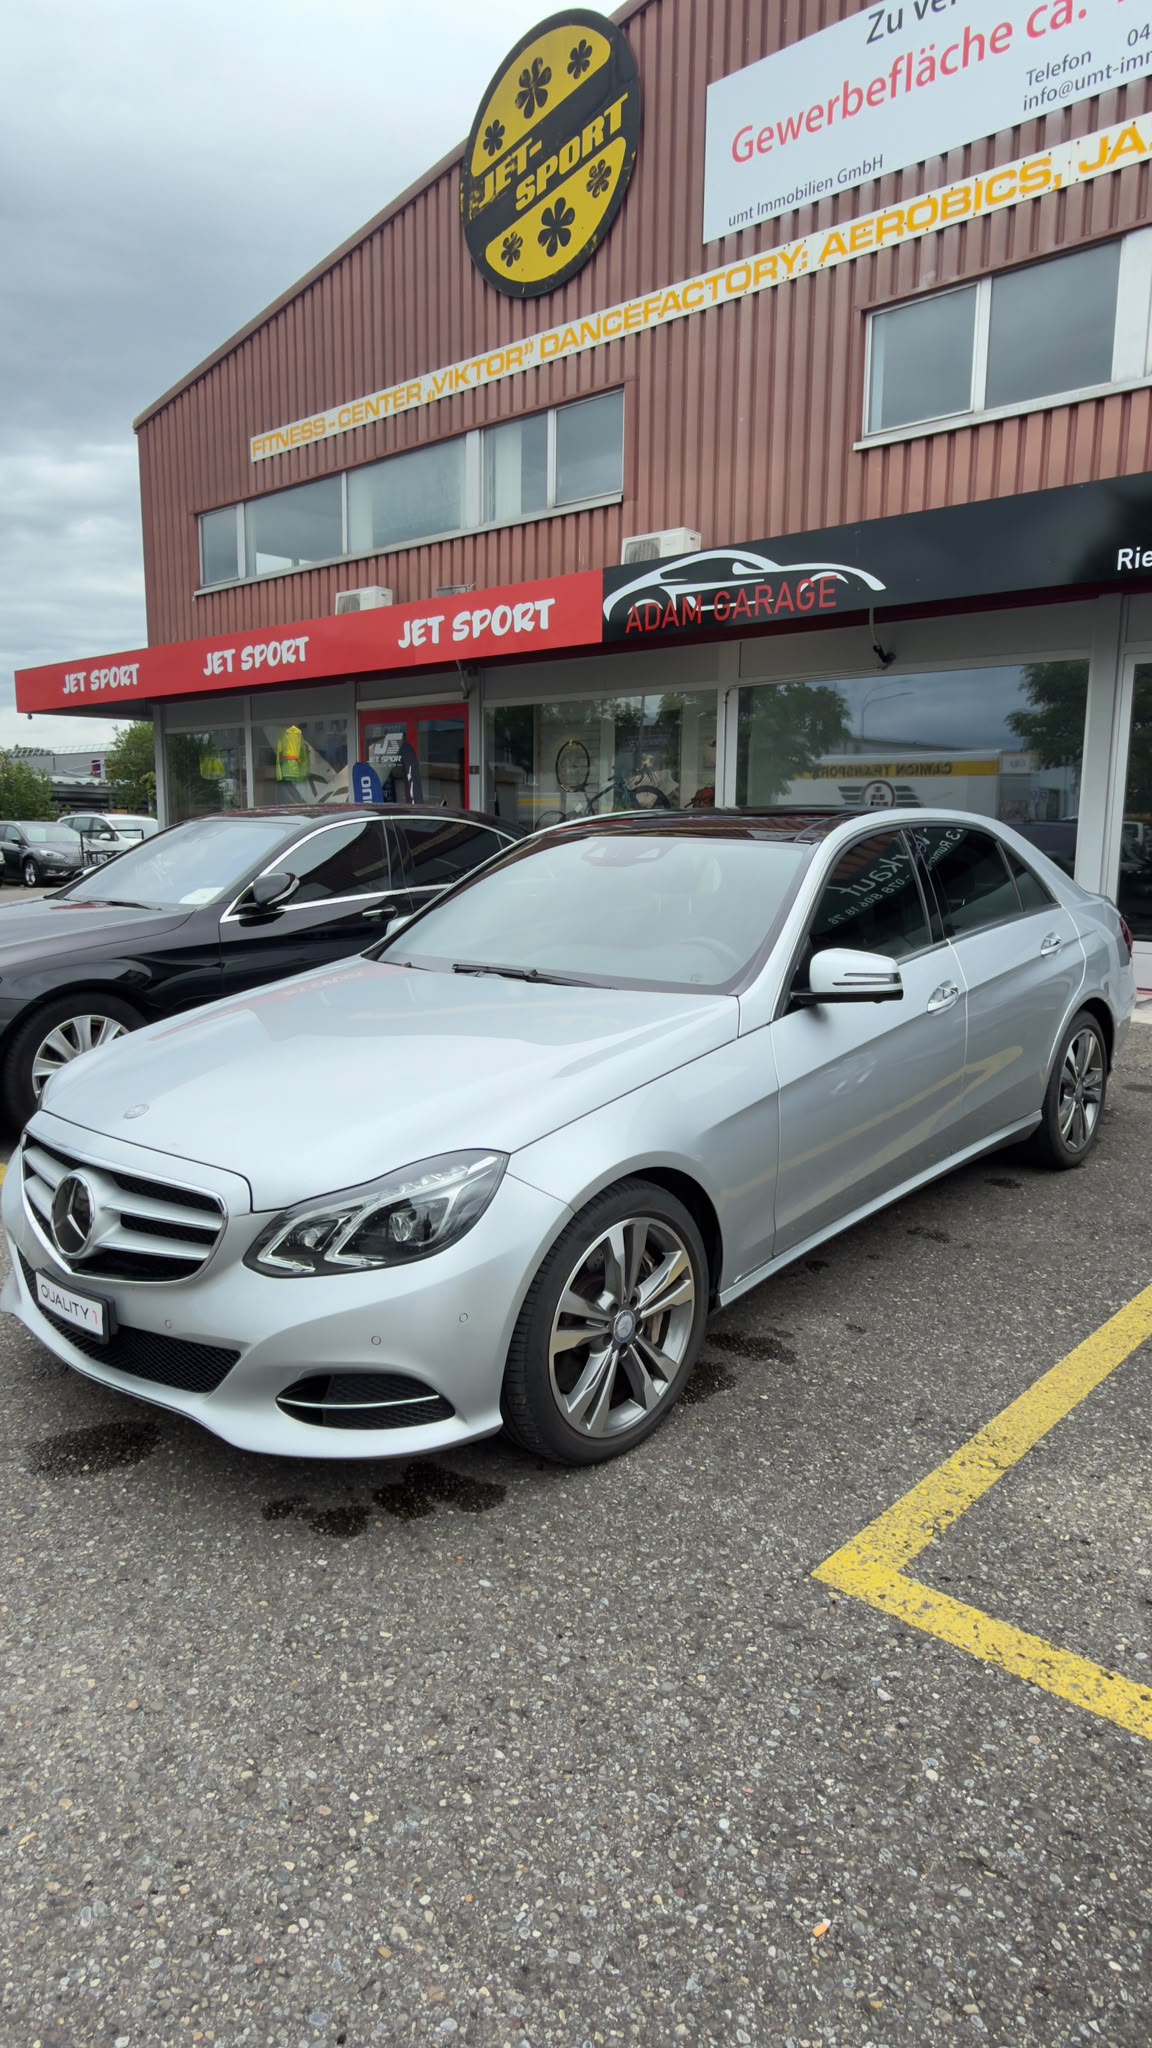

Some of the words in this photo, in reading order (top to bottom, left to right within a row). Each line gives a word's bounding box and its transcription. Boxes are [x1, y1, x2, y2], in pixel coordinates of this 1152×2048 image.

[866, 8, 903, 45] Zu
[1026, 51, 1092, 86] Telefon
[1127, 23, 1151, 47] 04
[732, 22, 1013, 163] Gewerbefläche
[1026, 0, 1087, 39] ca.
[479, 138, 543, 209] JET-
[515, 92, 629, 212] SPORT
[728, 206, 753, 226] umt
[757, 177, 833, 216] Immobilien
[837, 153, 884, 184] GmbH
[252, 417, 326, 458] FITNESS
[338, 382, 422, 429] CENTER
[539, 242, 809, 360] DANCEFACTORY:
[818, 155, 1062, 263] AEROBICS,
[1078, 125, 1152, 174] JA
[397, 614, 445, 649] JET
[452, 598, 556, 643] SPORT
[625, 594, 703, 634] ADAM
[712, 574, 839, 622] GARAGE
[63, 671, 87, 695] JET
[90, 663, 140, 691] SPORT
[203, 649, 236, 676] JET
[240, 636, 310, 671] SPORT
[40, 1283, 89, 1320] QUALITY
